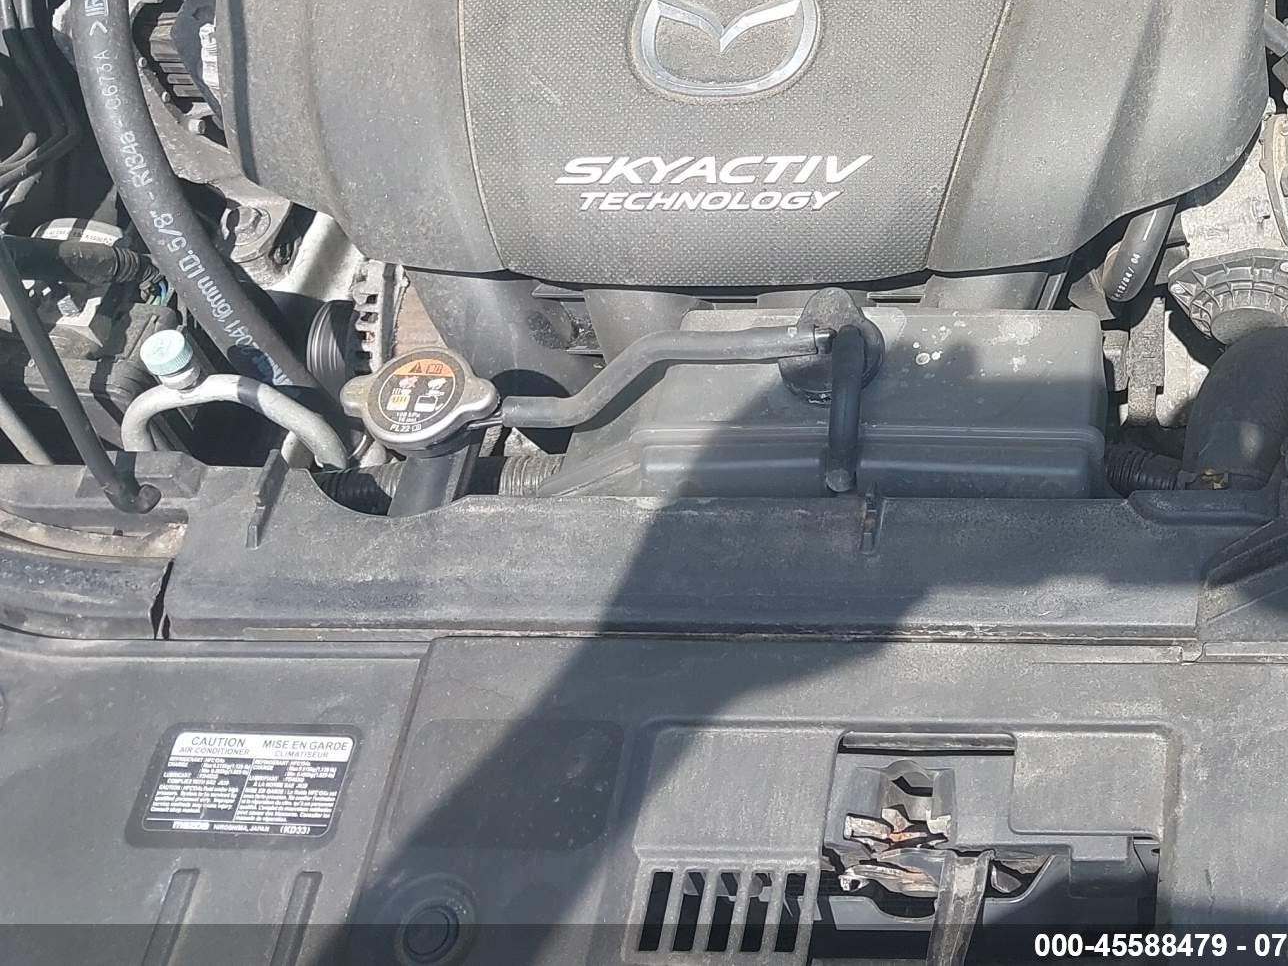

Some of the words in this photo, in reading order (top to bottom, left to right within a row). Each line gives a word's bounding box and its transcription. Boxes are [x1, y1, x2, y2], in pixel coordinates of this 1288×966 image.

[554, 153, 874, 186] SKYACTIV
[578, 190, 845, 213] TECHNOLOGY
[191, 736, 246, 747] CAUTION
[262, 739, 290, 749] MISE
[291, 740, 309, 750] EN
[309, 740, 349, 751] GARDE
[194, 746, 250, 756] CONDITIONER
[274, 750, 329, 758] CLIMATISEUR
[279, 825, 311, 835] (KD33)
